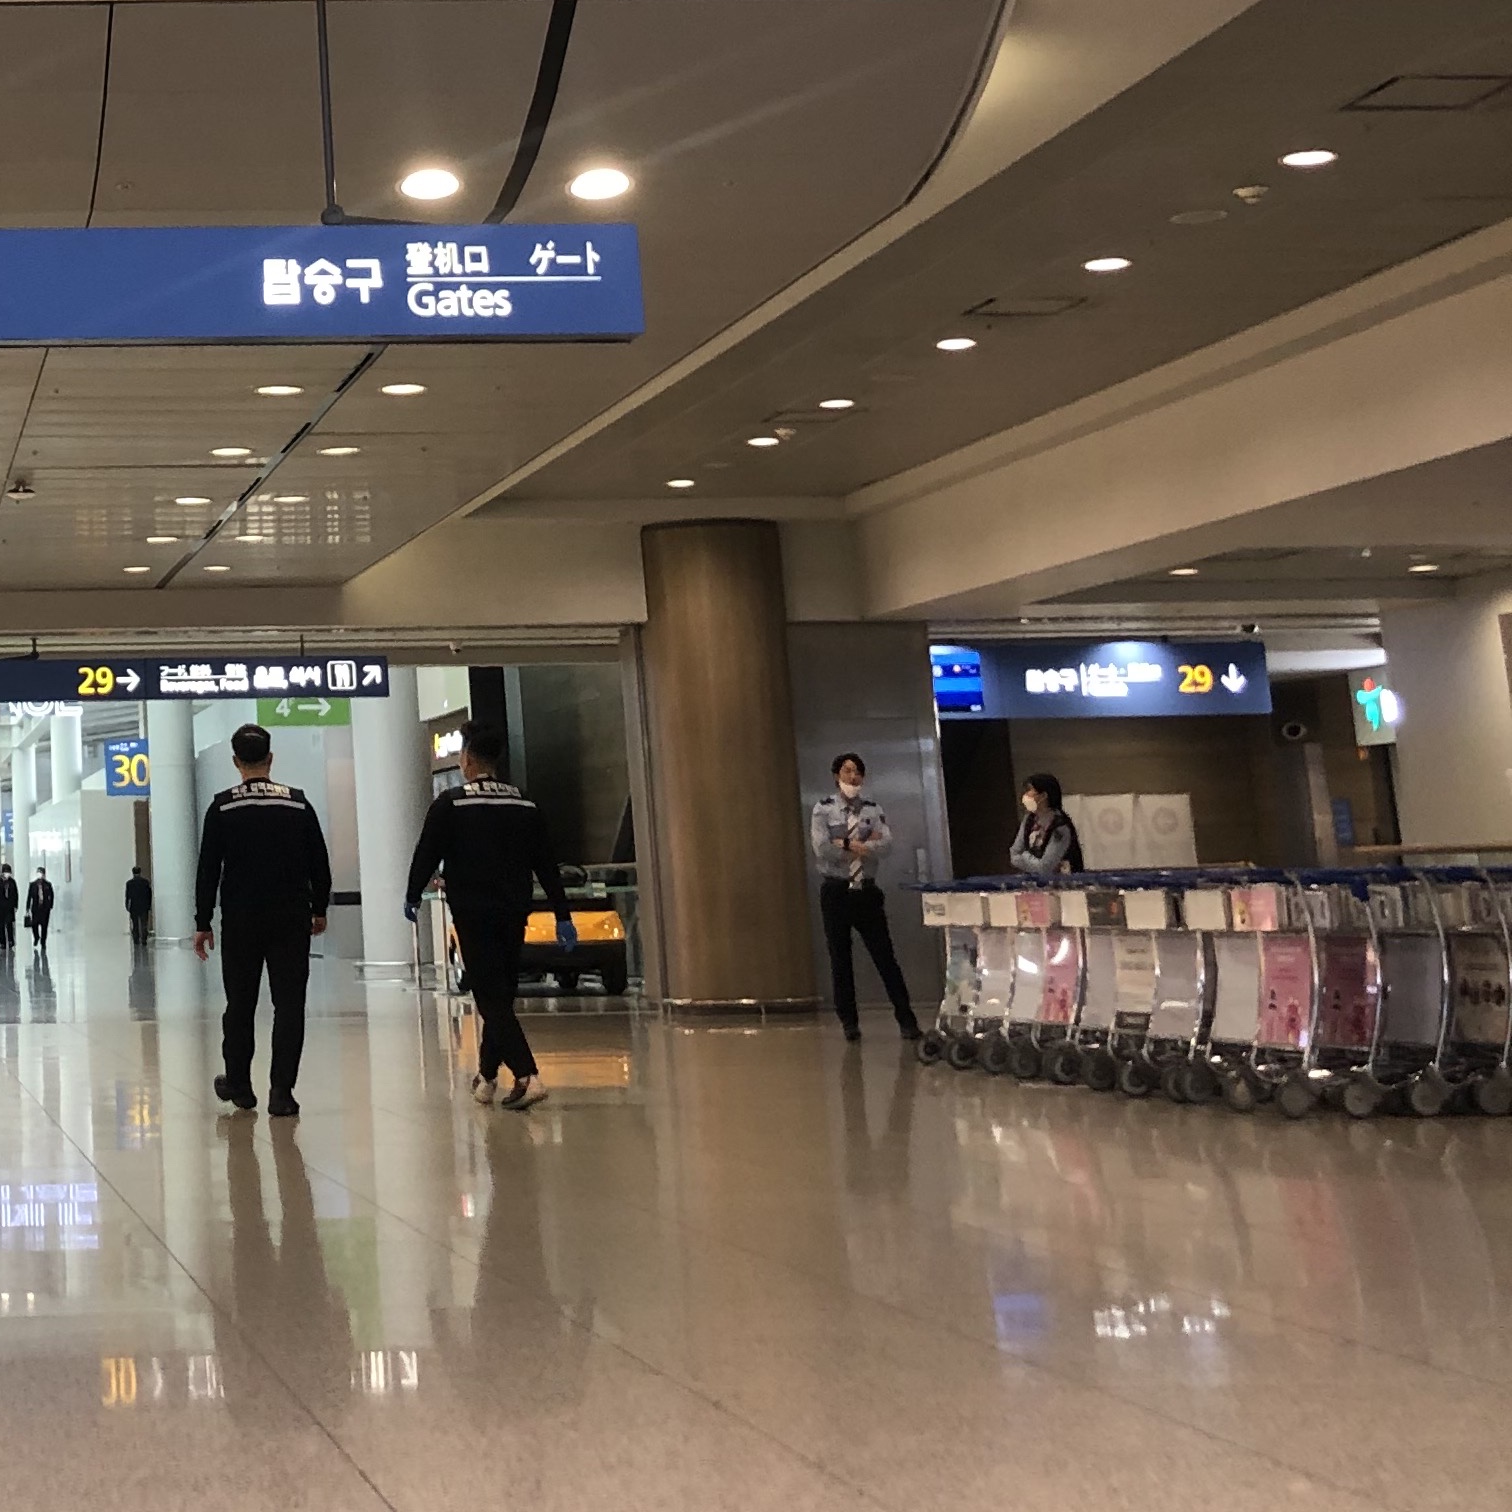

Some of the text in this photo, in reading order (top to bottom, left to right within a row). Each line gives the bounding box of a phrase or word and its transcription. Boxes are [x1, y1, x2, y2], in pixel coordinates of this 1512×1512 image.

[405, 241, 490, 276] 登机口
[529, 240, 601, 275] ゲート
[262, 257, 384, 306] 탑승구
[406, 282, 512, 317] Gates
[77, 665, 115, 696] 29
[1177, 663, 1215, 695] 29
[112, 753, 150, 788] 30
